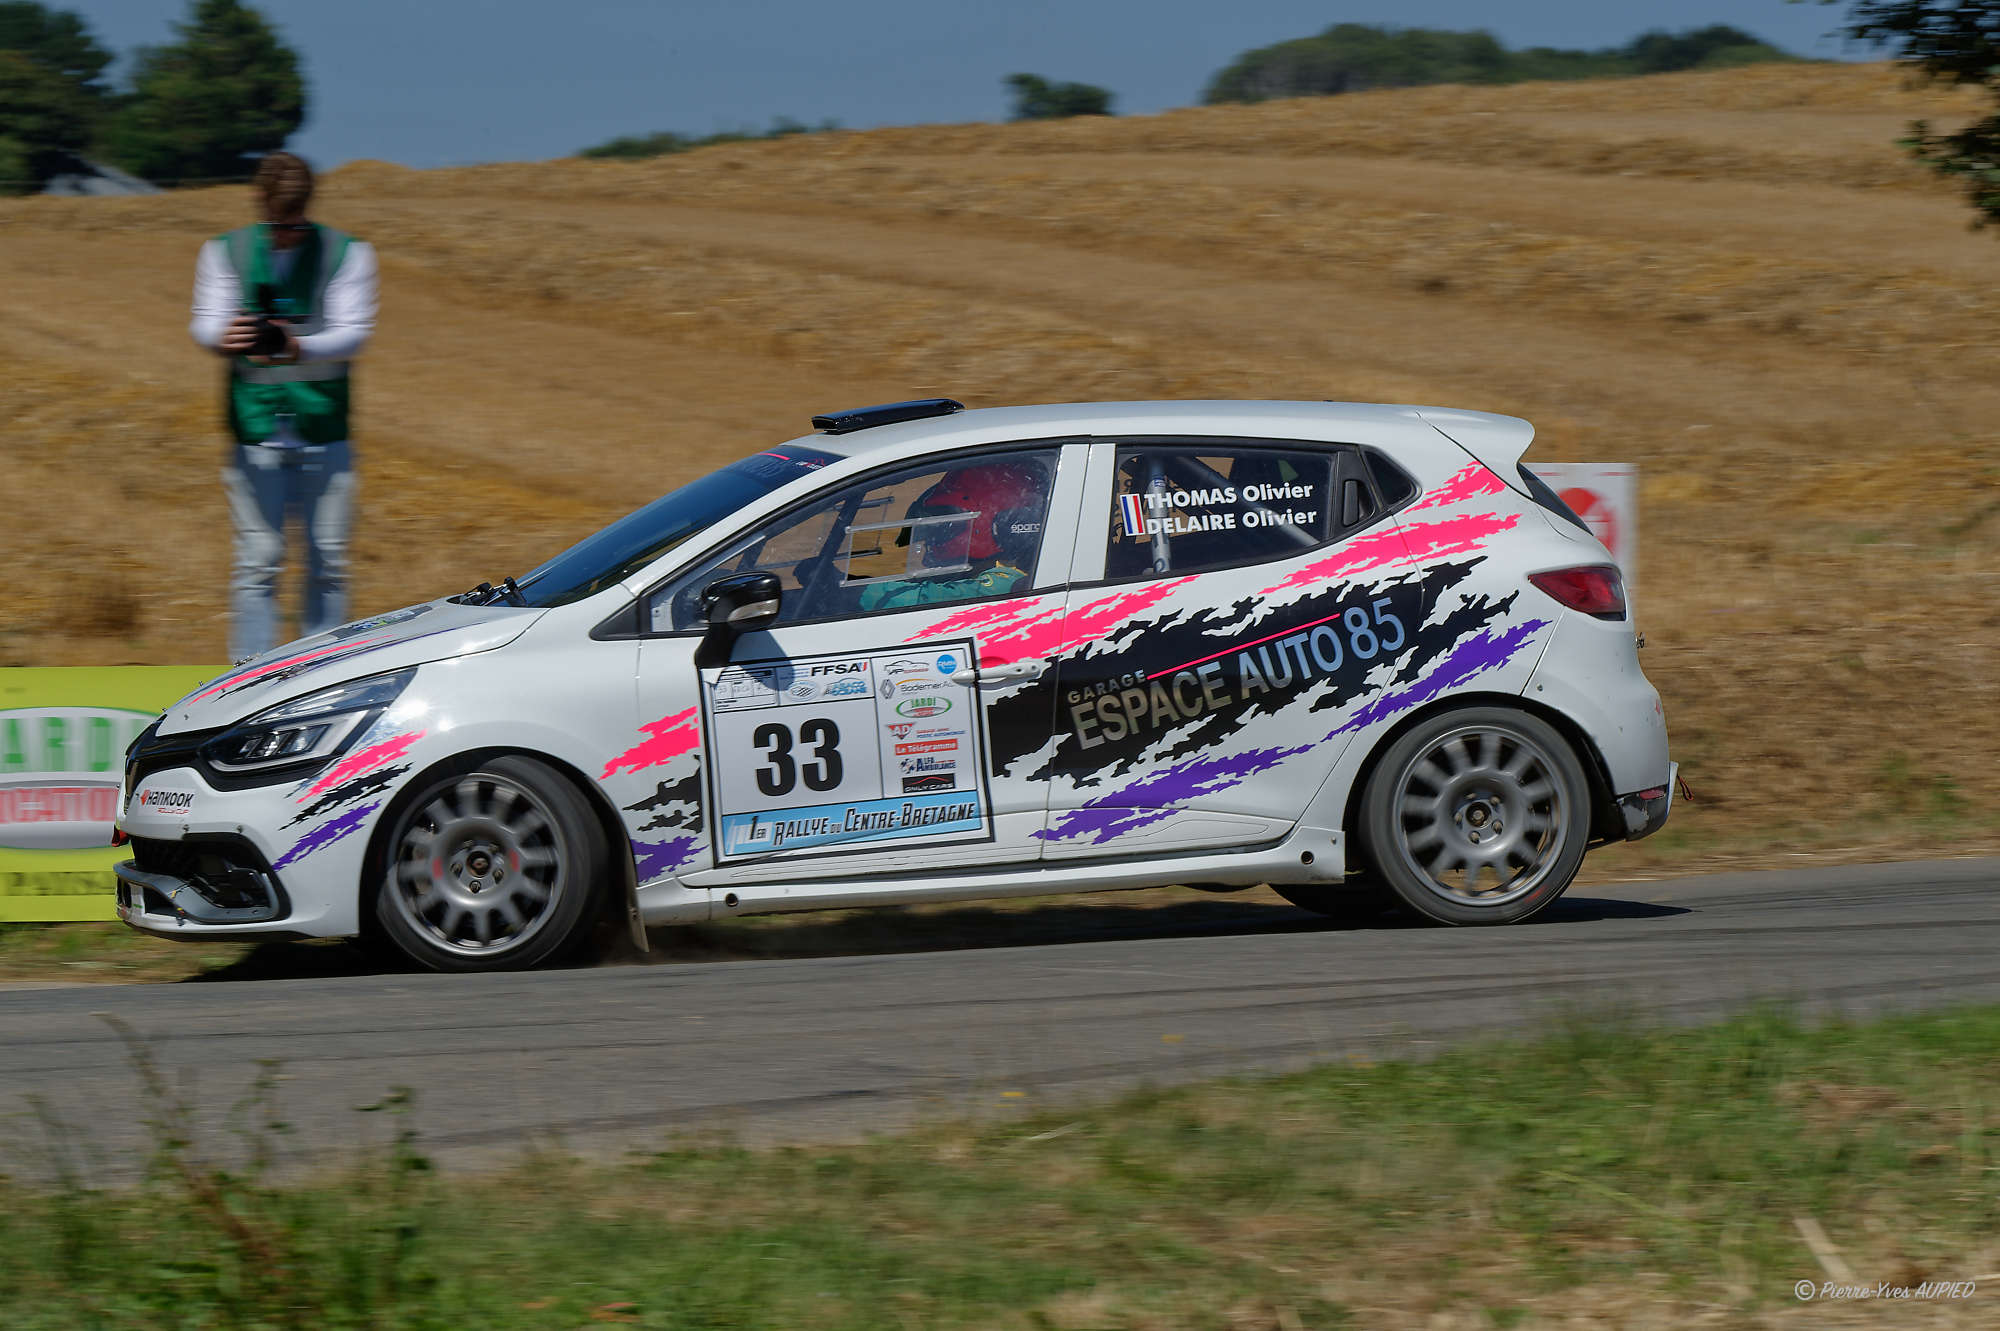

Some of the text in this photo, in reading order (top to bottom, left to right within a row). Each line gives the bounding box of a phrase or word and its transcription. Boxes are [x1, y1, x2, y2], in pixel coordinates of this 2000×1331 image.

[1144, 482, 1314, 509] THOMAS Olivier
[1145, 509, 1317, 535] DELAIRE Olivier
[811, 662, 861, 677] FFSA
[1067, 669, 1146, 704] GARAGE
[1070, 597, 1405, 750] ESPACE AUTO 85
[753, 718, 843, 796] 33
[773, 816, 830, 846] RALLYE
[844, 802, 976, 832] CENTRE-BRETAGNE
